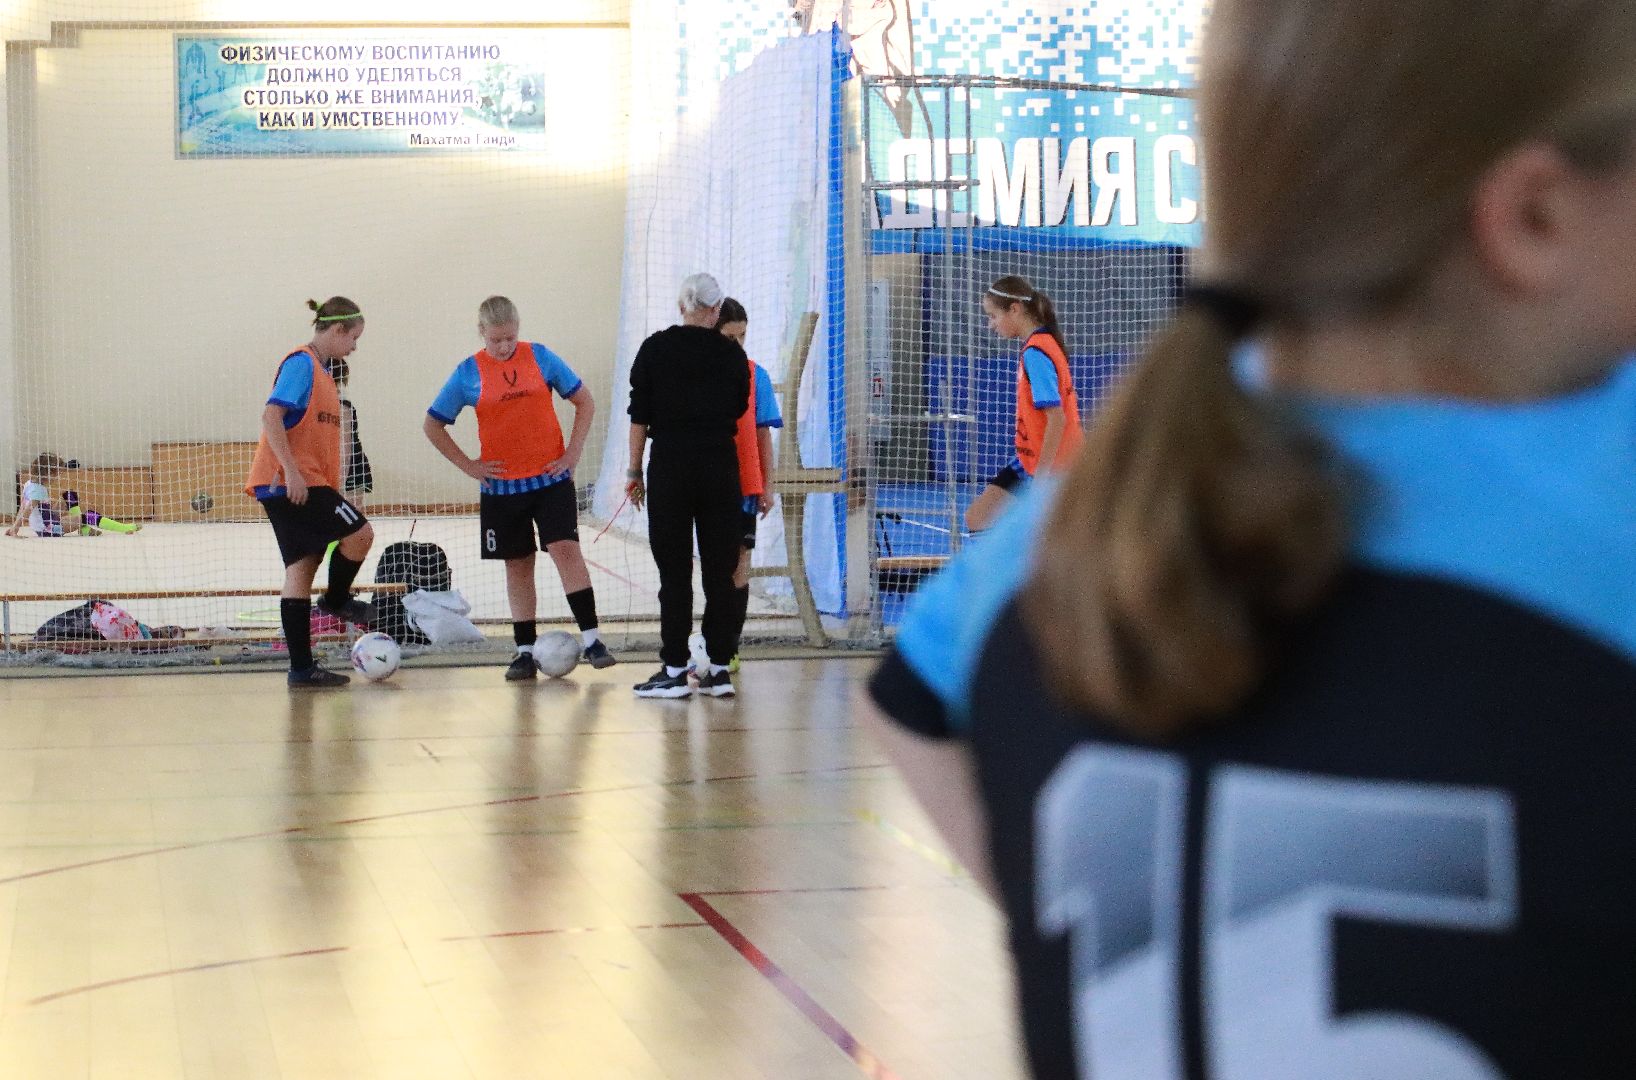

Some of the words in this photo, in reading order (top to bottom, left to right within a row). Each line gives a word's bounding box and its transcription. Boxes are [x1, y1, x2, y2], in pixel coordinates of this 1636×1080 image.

[220, 45, 365, 62] ФИЗИЧЕСКОМУ
[372, 44, 501, 61] ВОСПИТАНИЮ
[266, 67, 349, 86] ДОЛЖНО
[356, 66, 462, 85] УДЕЛЯТЬСЯ
[243, 89, 329, 106] СТОЛЬКО
[335, 89, 364, 105] ЖЕ
[371, 88, 479, 107] ВНИМАНИЯ,
[259, 111, 296, 127] КАК
[302, 111, 314, 127] И
[321, 110, 465, 127] УМСТВЕННОМУ.
[410, 133, 470, 146] Махатма
[476, 132, 515, 148] Ганди
[335, 500, 359, 525] 11
[486, 529, 497, 552] 6
[1034, 740, 1521, 1080] 15
